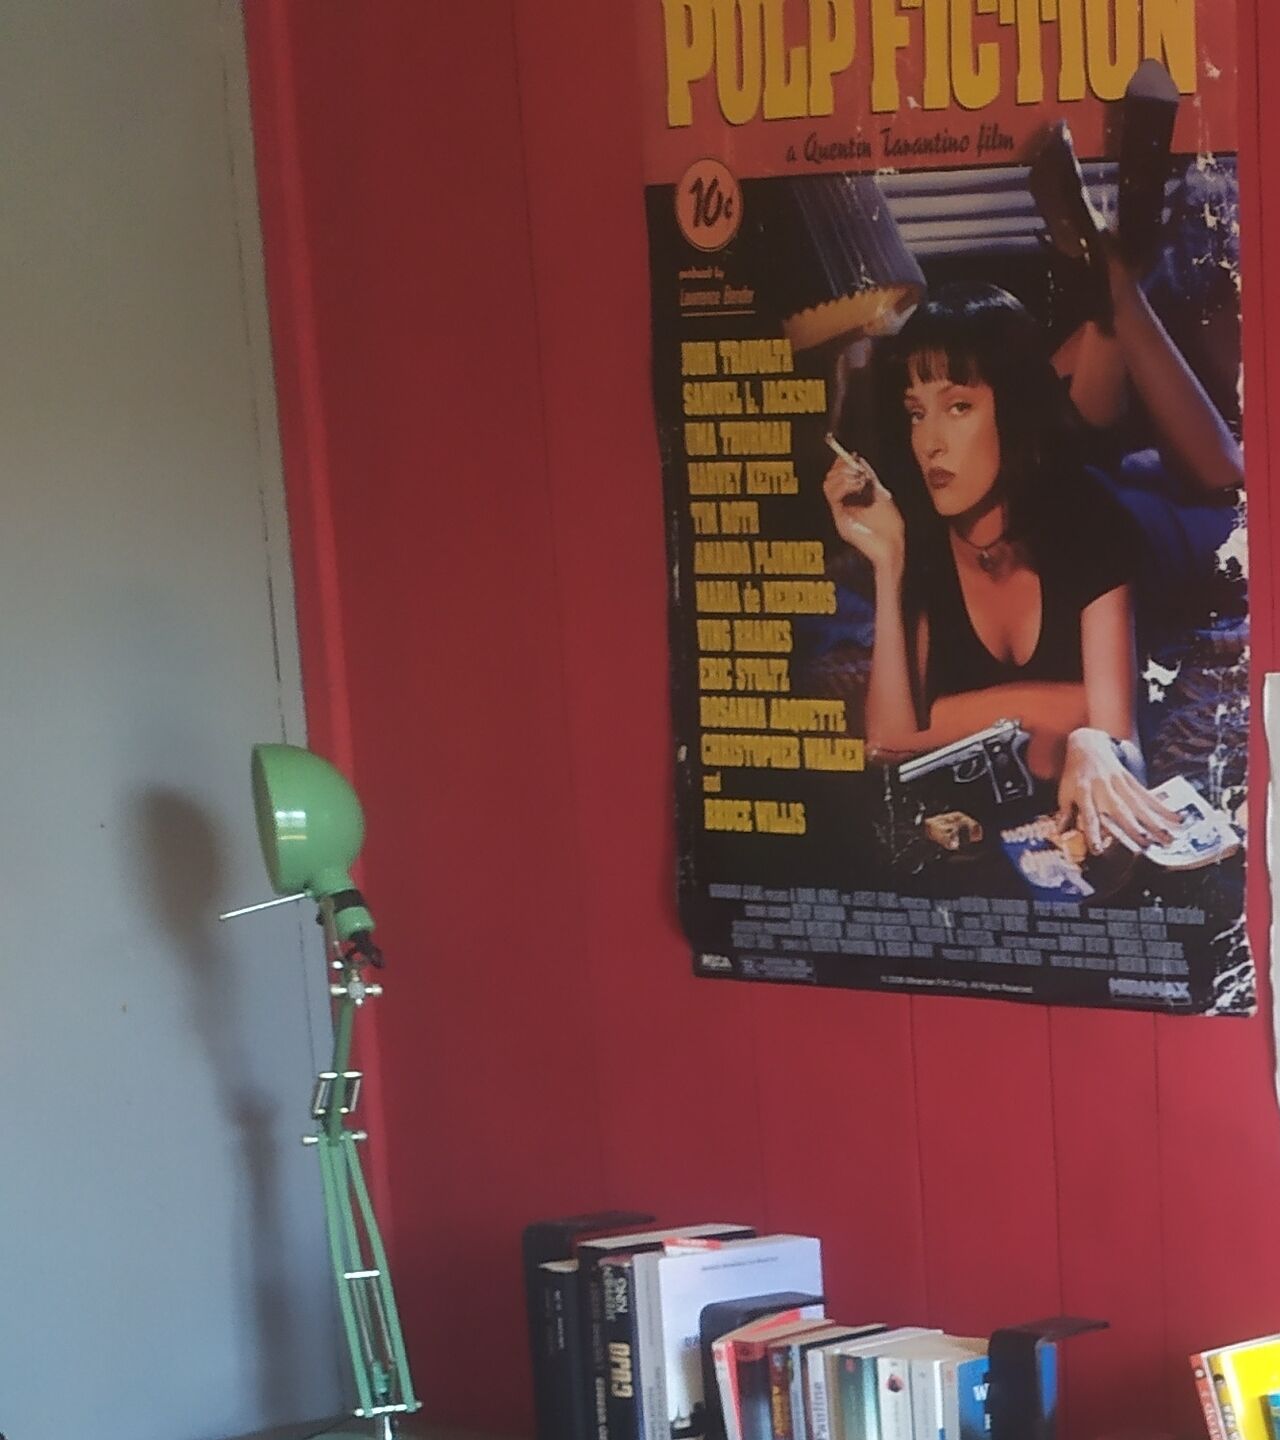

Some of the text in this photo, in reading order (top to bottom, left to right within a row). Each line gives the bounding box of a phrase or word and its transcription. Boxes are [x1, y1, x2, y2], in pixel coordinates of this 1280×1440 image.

[661, 0, 1199, 128] PULP FICTION
[804, 131, 872, 164] Quentin
[880, 127, 970, 158] Tarantino
[976, 122, 1015, 158] film
